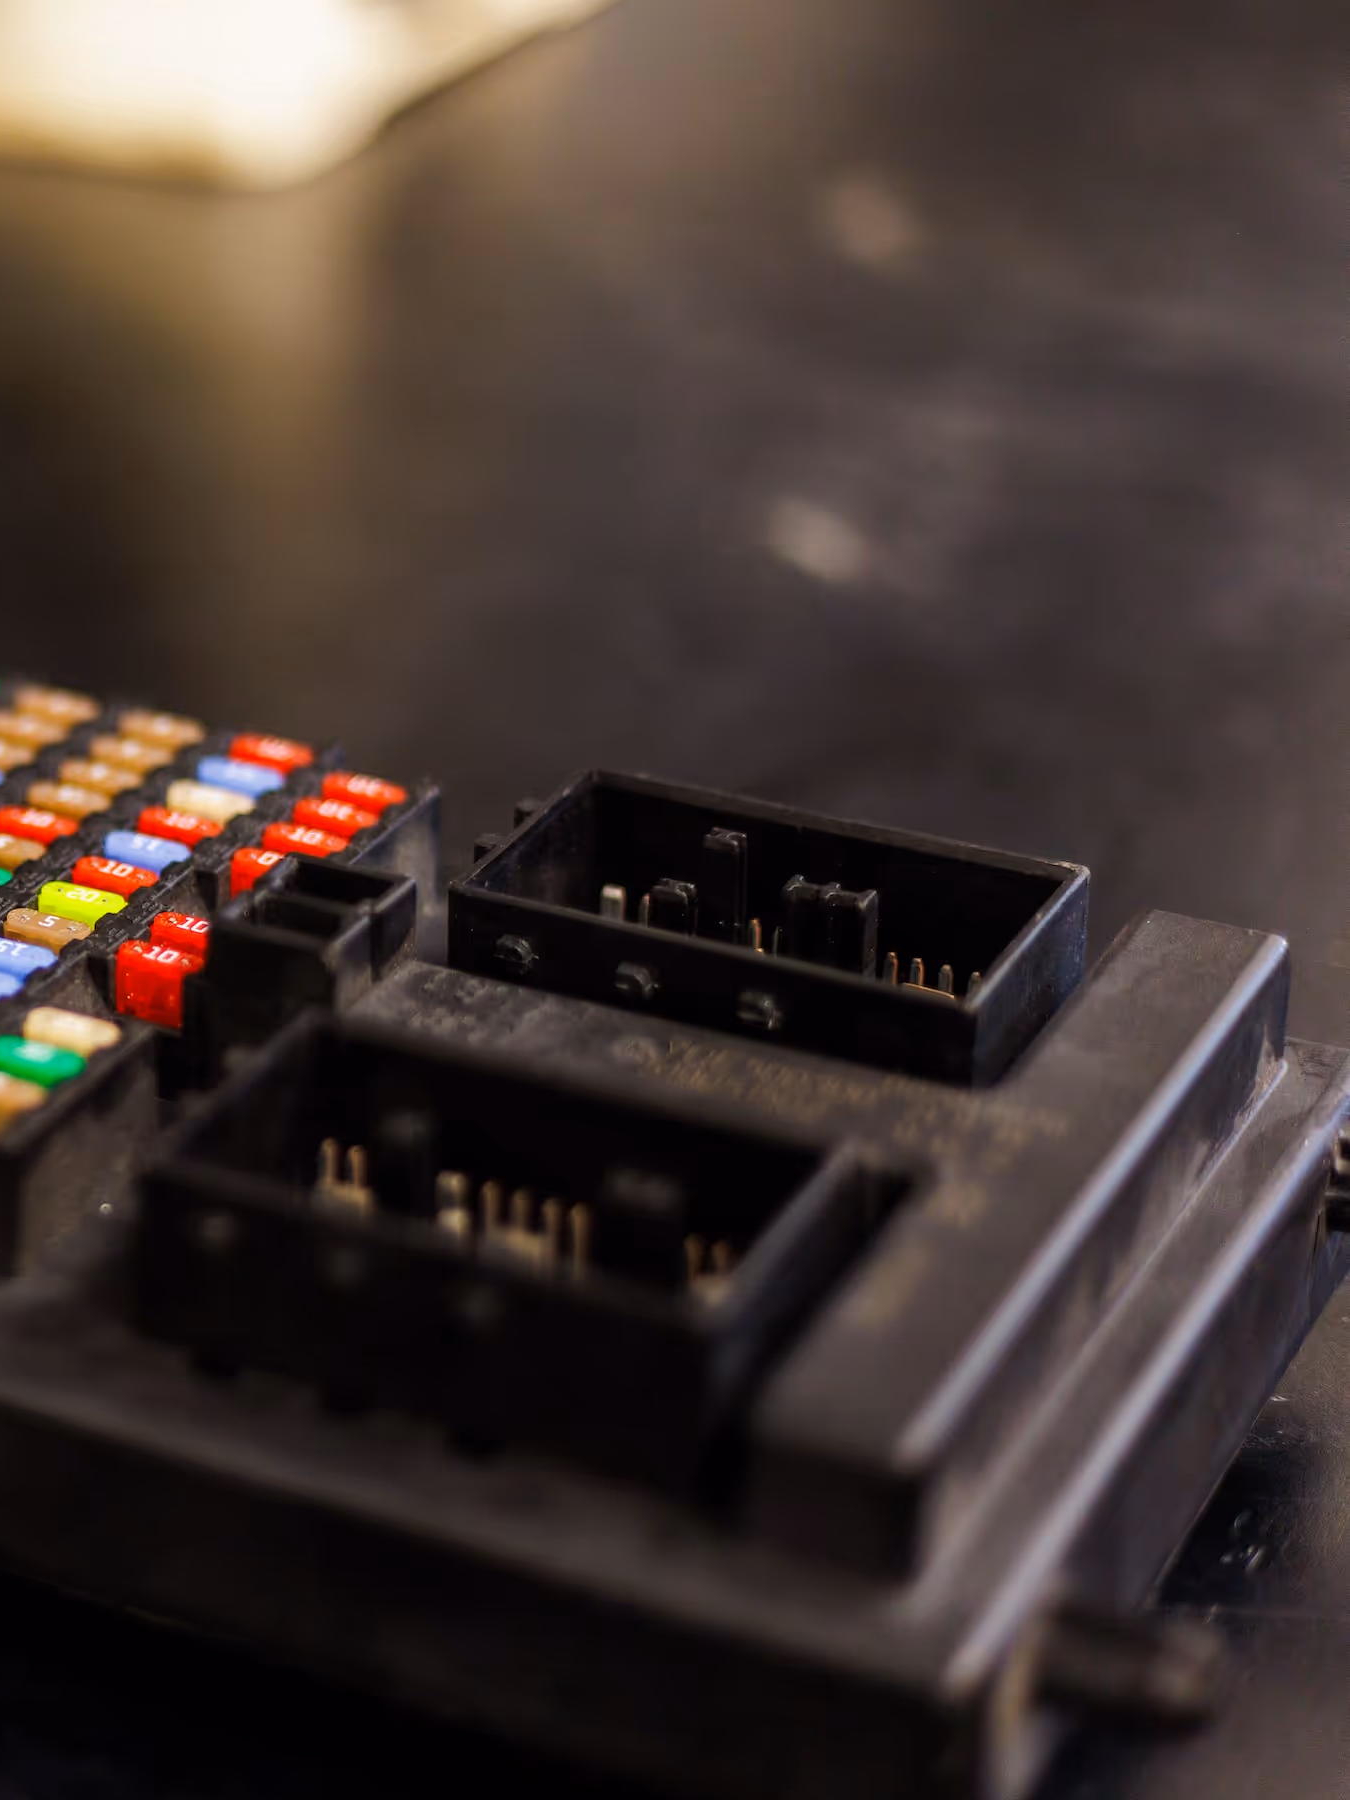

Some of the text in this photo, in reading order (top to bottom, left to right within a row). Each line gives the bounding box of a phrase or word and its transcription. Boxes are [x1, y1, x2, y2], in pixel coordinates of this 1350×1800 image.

[288, 828, 324, 845] 10
[99, 861, 135, 877] 10
[66, 887, 101, 903] 20
[38, 916, 60, 927] 5
[177, 917, 209, 934] 10
[143, 946, 181, 963] 10
